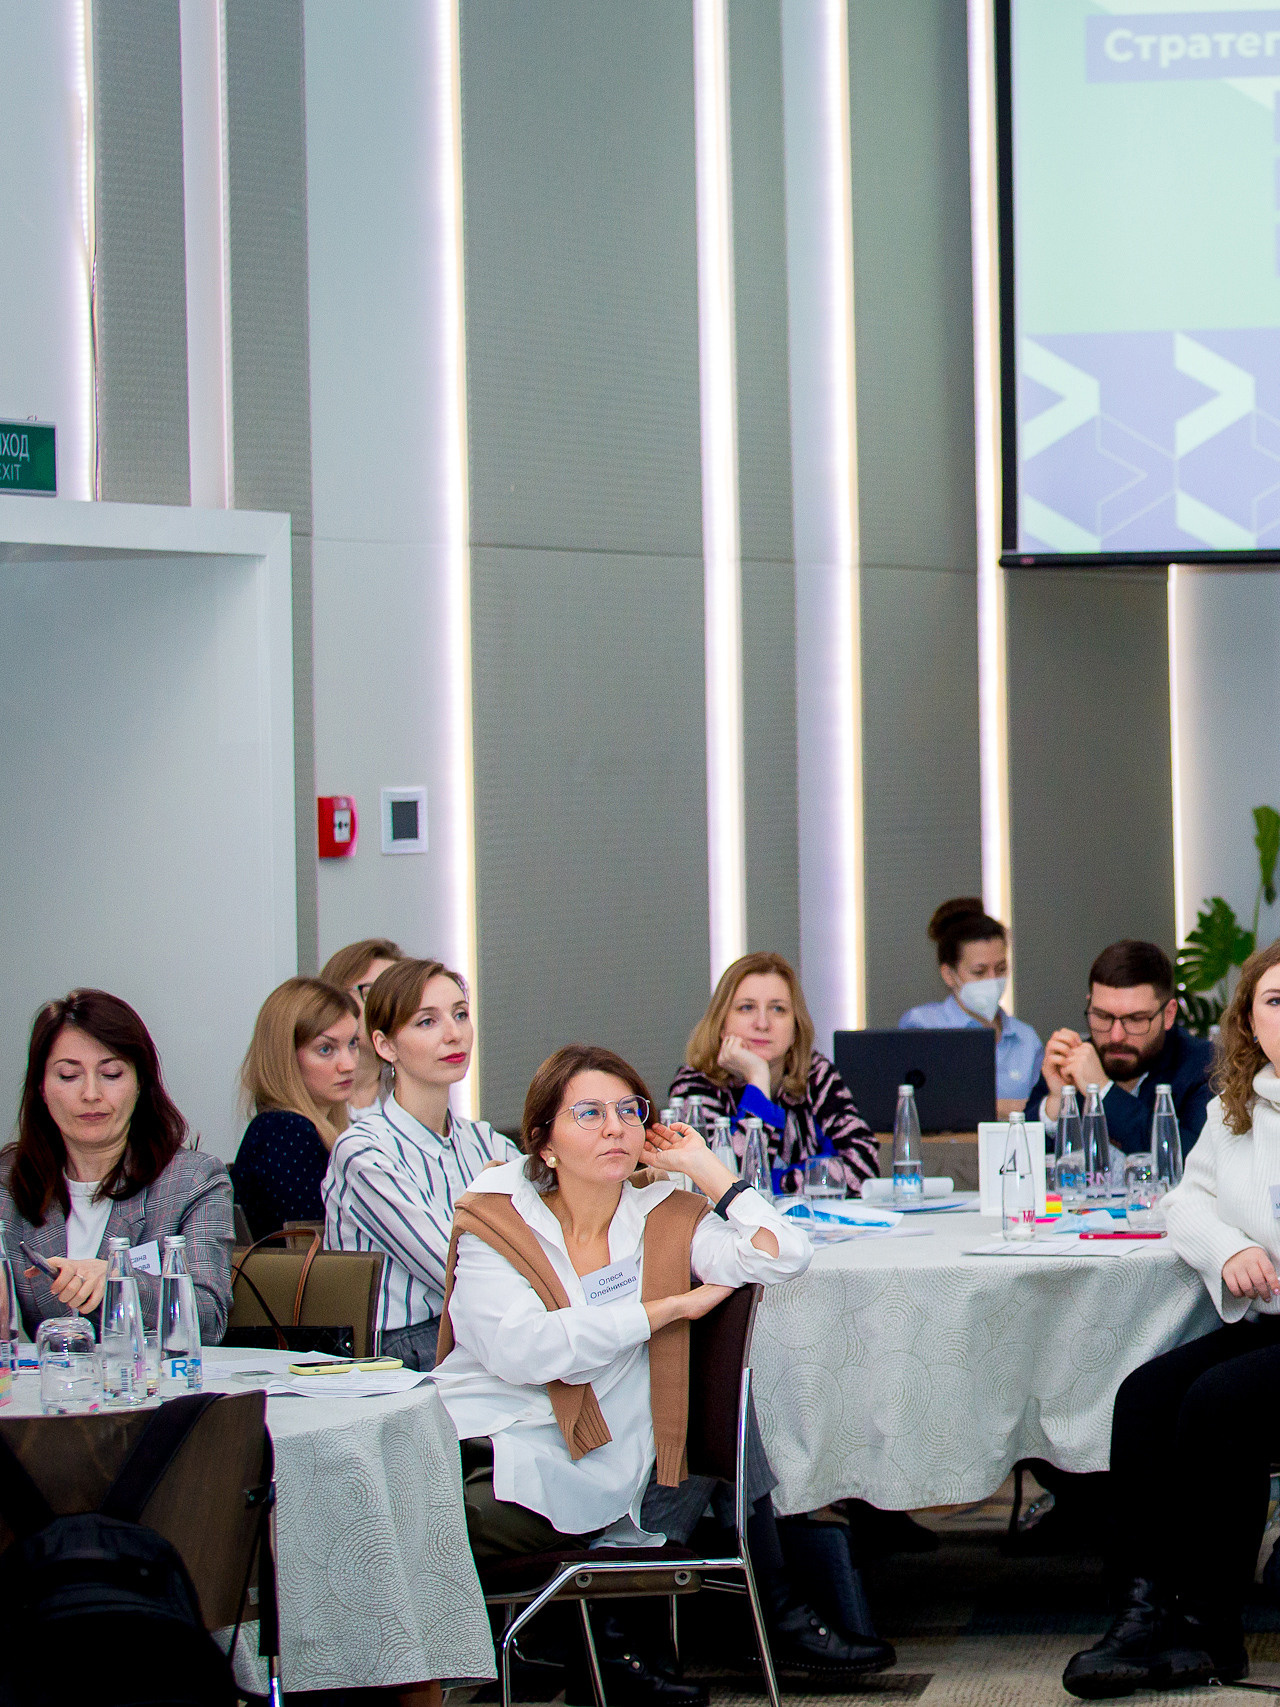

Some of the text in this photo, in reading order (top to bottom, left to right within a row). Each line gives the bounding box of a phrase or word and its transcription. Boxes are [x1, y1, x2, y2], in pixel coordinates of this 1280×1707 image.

[0, 463, 21, 481] XIT
[590, 1275, 637, 1300] Олейникова
[598, 1271, 624, 1286] Олеся
